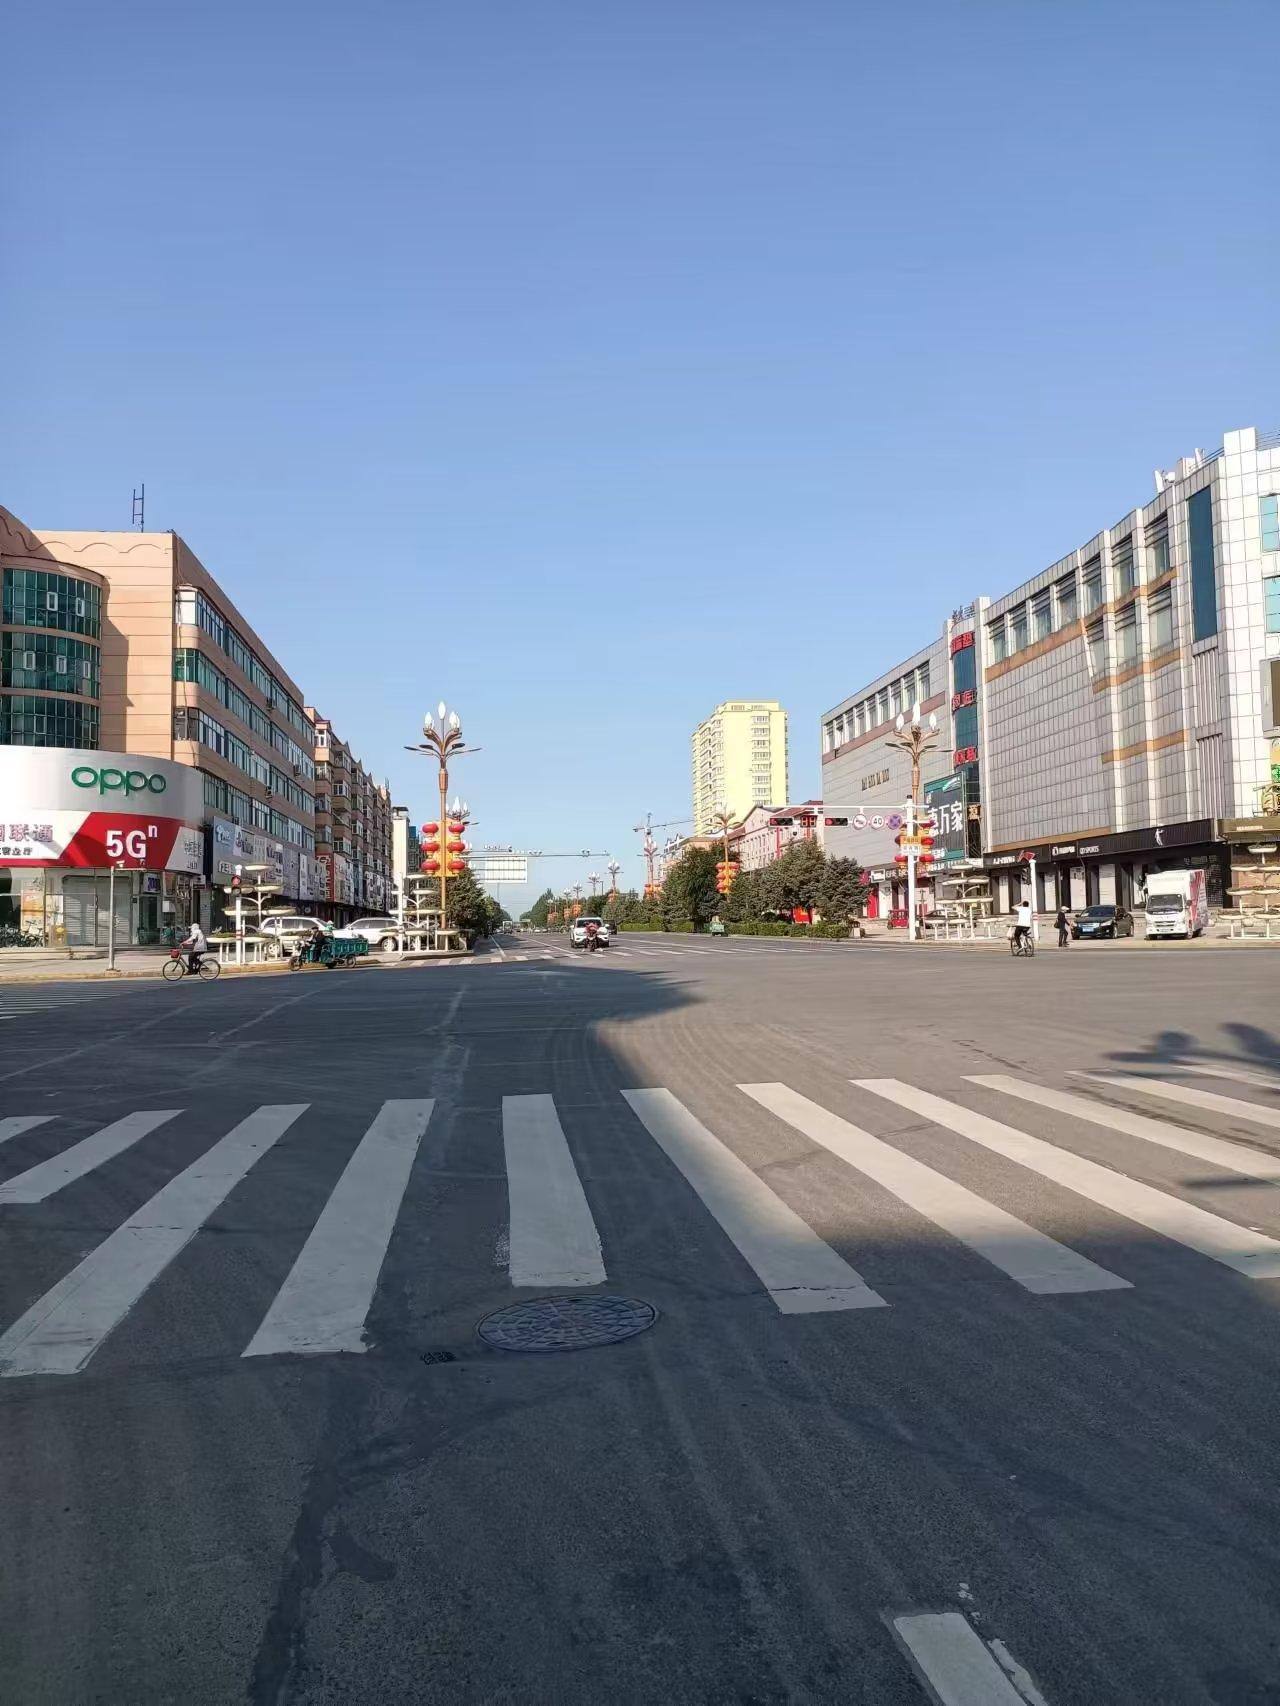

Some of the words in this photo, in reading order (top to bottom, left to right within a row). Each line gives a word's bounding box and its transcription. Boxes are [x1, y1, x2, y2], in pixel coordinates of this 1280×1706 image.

[71, 766, 167, 797] oppo
[873, 817, 883, 825] 40
[0, 847, 33, 856] 营业厅
